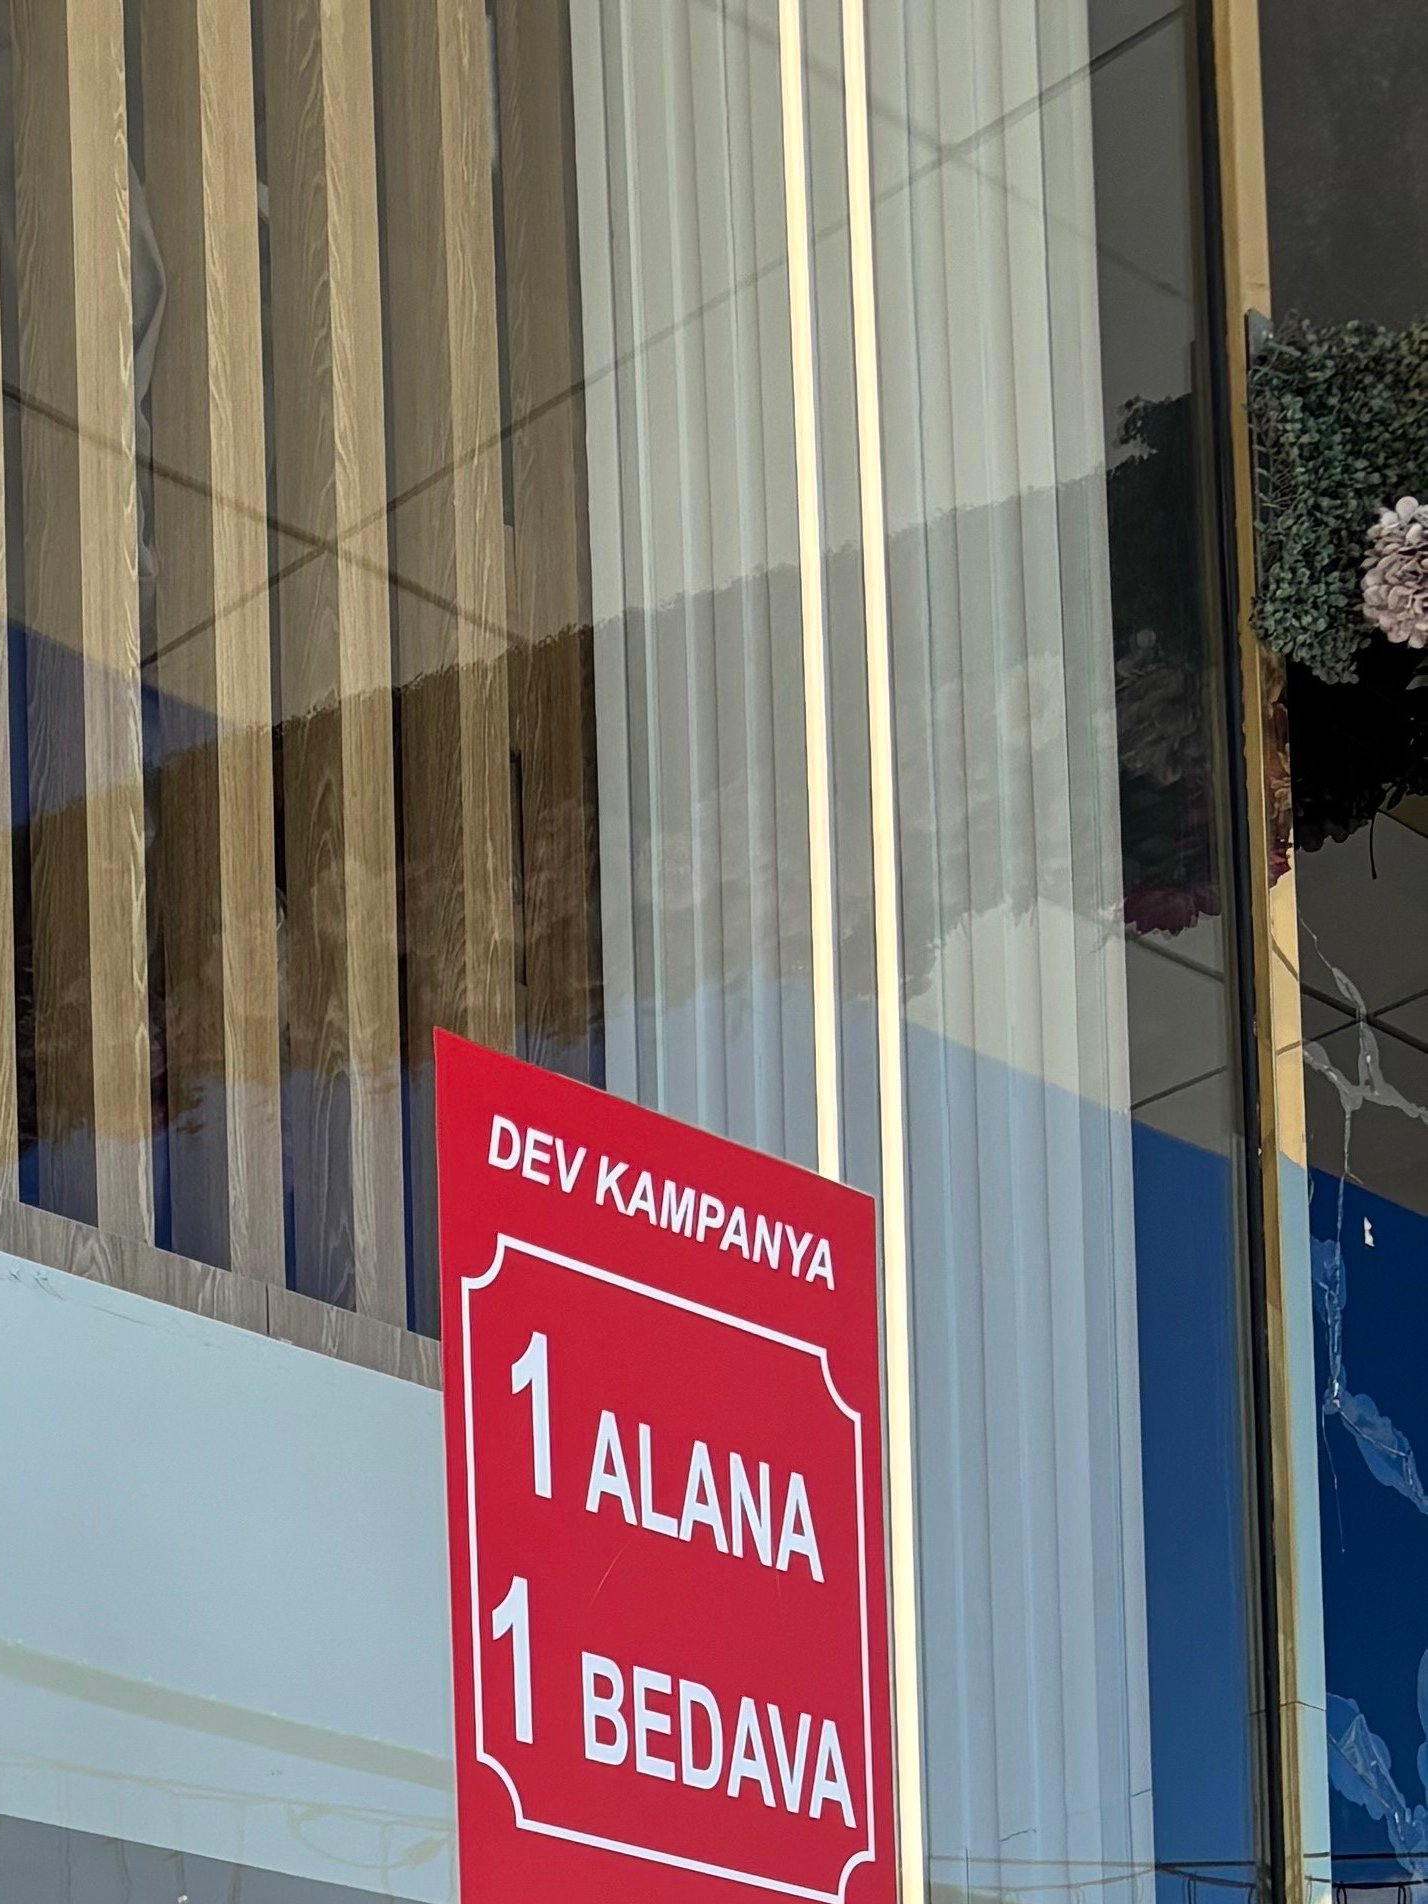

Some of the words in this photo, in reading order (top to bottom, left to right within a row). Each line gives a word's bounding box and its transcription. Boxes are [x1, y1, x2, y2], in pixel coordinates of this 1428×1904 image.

[488, 1114, 587, 1193] DEV
[595, 1155, 835, 1291] KAMPANYA
[510, 1331, 552, 1499] 1
[585, 1409, 825, 1583] ALANA
[491, 1575, 533, 1745] 1
[581, 1651, 857, 1829] BEDAVA
